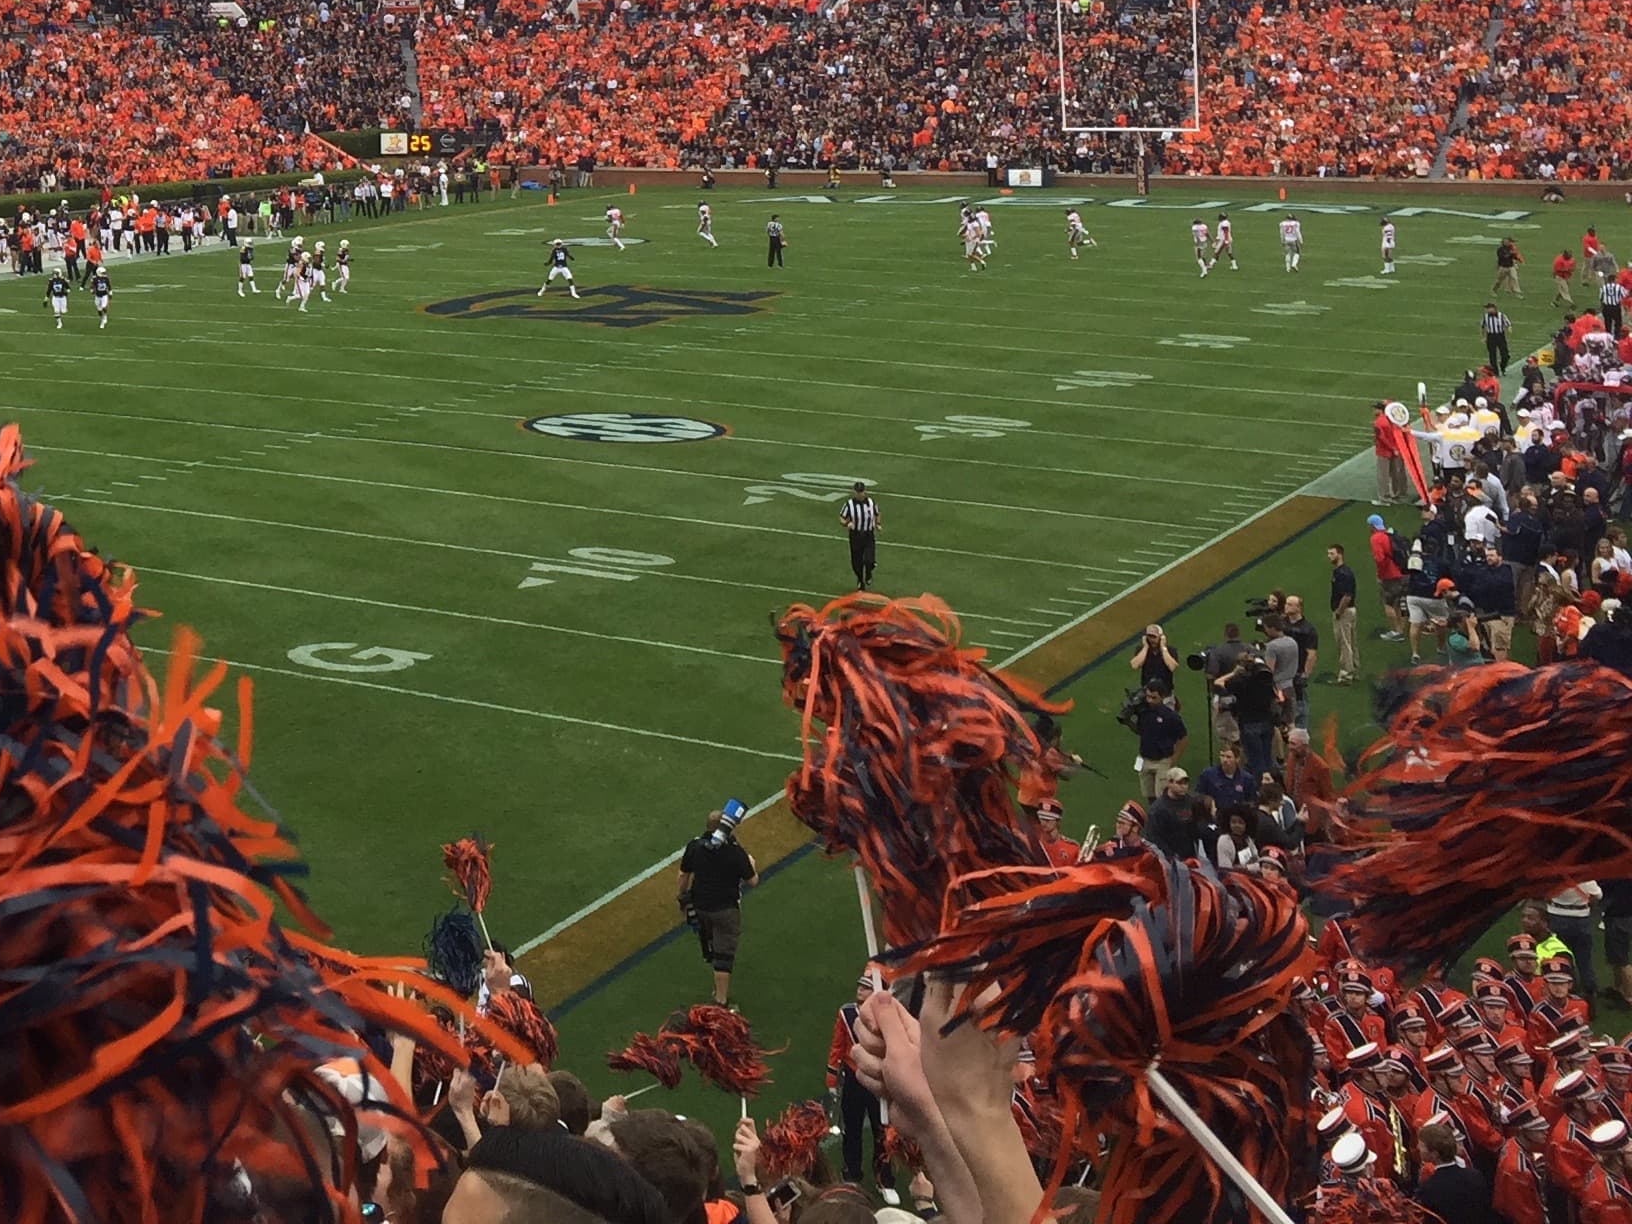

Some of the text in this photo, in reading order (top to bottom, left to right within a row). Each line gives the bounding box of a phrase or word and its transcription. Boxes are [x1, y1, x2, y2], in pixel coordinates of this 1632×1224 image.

[410, 135, 432, 152] 25
[913, 414, 1033, 438] 30
[743, 471, 879, 503] 20
[528, 546, 677, 583] 10
[286, 641, 434, 673] G
